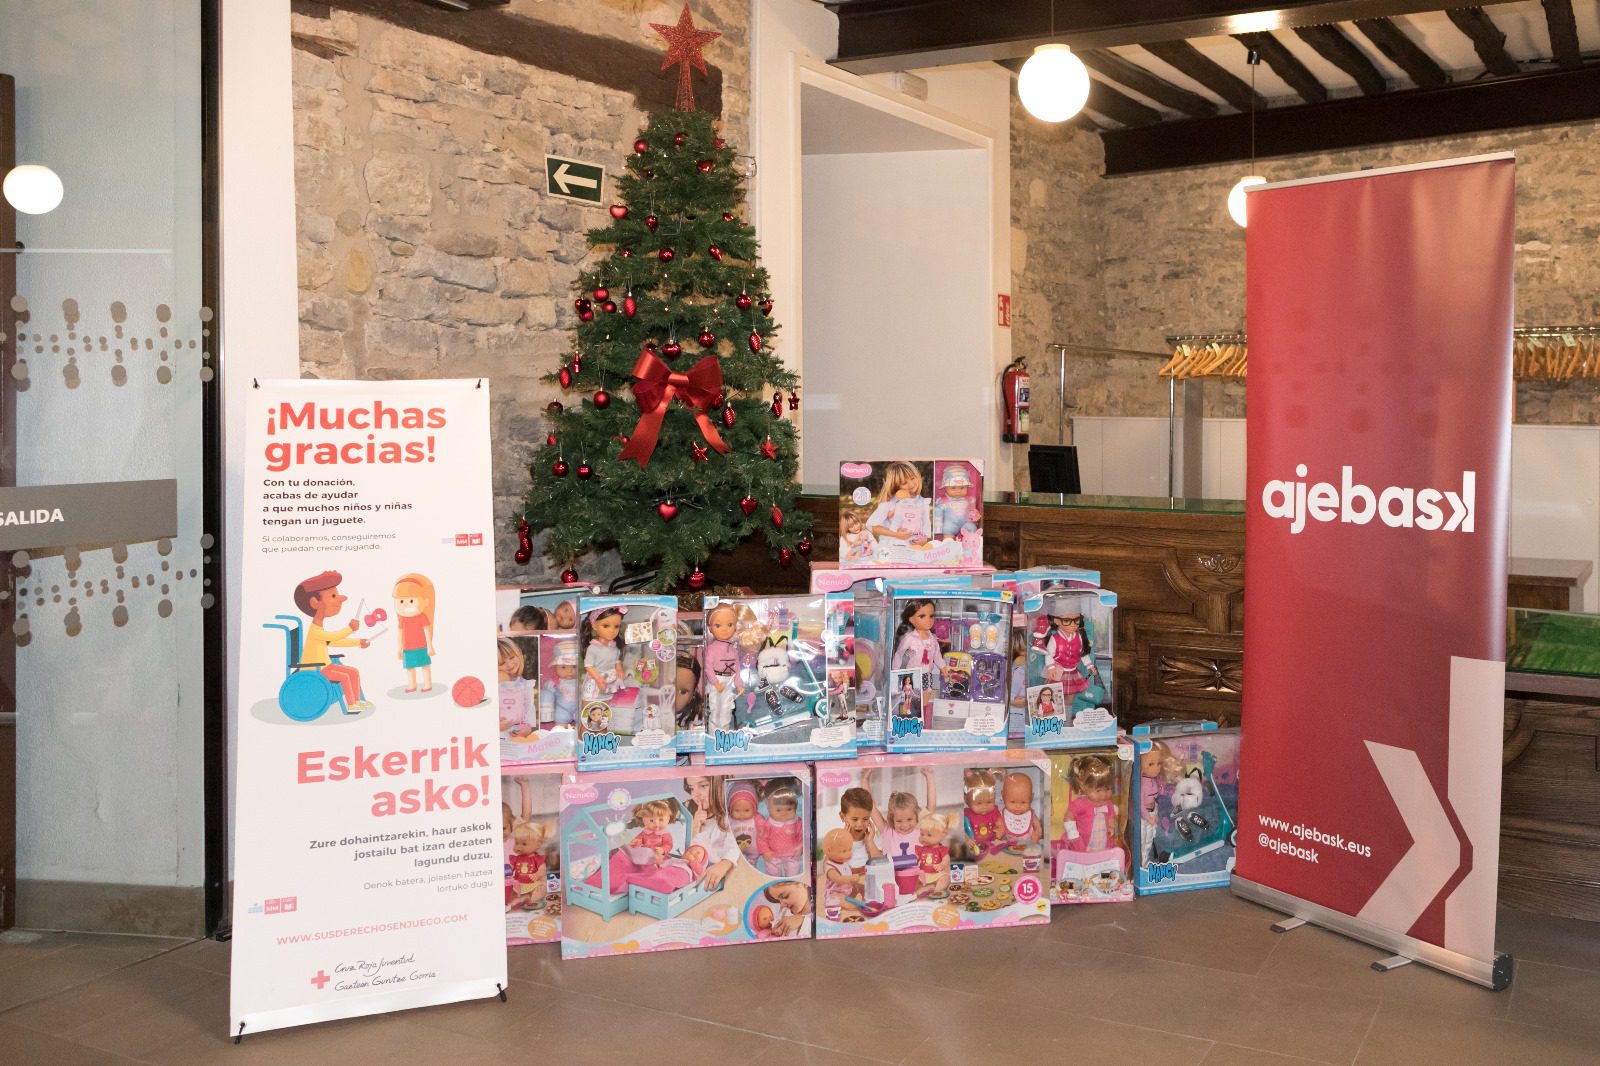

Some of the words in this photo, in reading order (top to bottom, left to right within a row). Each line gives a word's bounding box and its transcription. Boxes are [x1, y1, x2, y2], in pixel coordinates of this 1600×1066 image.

[267, 401, 447, 436] ¡Muchas
[265, 434, 436, 472] gracias!
[263, 479, 285, 487] Con
[288, 479, 300, 487] tu
[263, 491, 301, 500] acabas
[304, 491, 318, 499] de
[321, 491, 358, 501] ayudar
[1262, 463, 1476, 534] ajebask
[272, 505, 294, 514] que
[297, 503, 340, 512] muchos
[343, 502, 372, 511] niños
[375, 503, 381, 512] y
[384, 501, 413, 510] niñas
[262, 518, 301, 527] tengan
[305, 517, 319, 525] un
[321, 516, 366, 526] juguete.
[261, 546, 279, 554] que
[281, 544, 315, 554] puedan
[316, 544, 343, 552] crecer
[272, 534, 330, 543] colaboramos,
[332, 533, 396, 542] conseguiremos
[891, 716, 923, 737] NANCY
[1031, 717, 1063, 736] NANCY
[583, 732, 620, 755] NANCY
[715, 729, 751, 752] NANCY
[297, 736, 490, 784] Eskerrik
[370, 775, 490, 817] asko!
[309, 839, 337, 849] Zure
[432, 827, 457, 836] haur
[460, 822, 492, 833] askok
[1258, 814, 1371, 858] www.ajebask.eus
[353, 847, 397, 862] jostailu
[400, 844, 419, 854] bat
[422, 842, 445, 851] izan
[448, 837, 493, 849] dezaten
[1258, 833, 1319, 864] @ajebask
[414, 854, 460, 868] lagundu
[463, 852, 493, 862] duzu.
[363, 879, 393, 890] Denok
[395, 875, 426, 886] batera,
[464, 868, 493, 878] haztea
[1148, 862, 1178, 883] NANCY
[437, 883, 469, 893] lortuko
[470, 879, 494, 890] dugu
[1022, 882, 1034, 894] 15
[276, 912, 468, 945] WWW.SUSDERECHOSENJUEGO.COM
